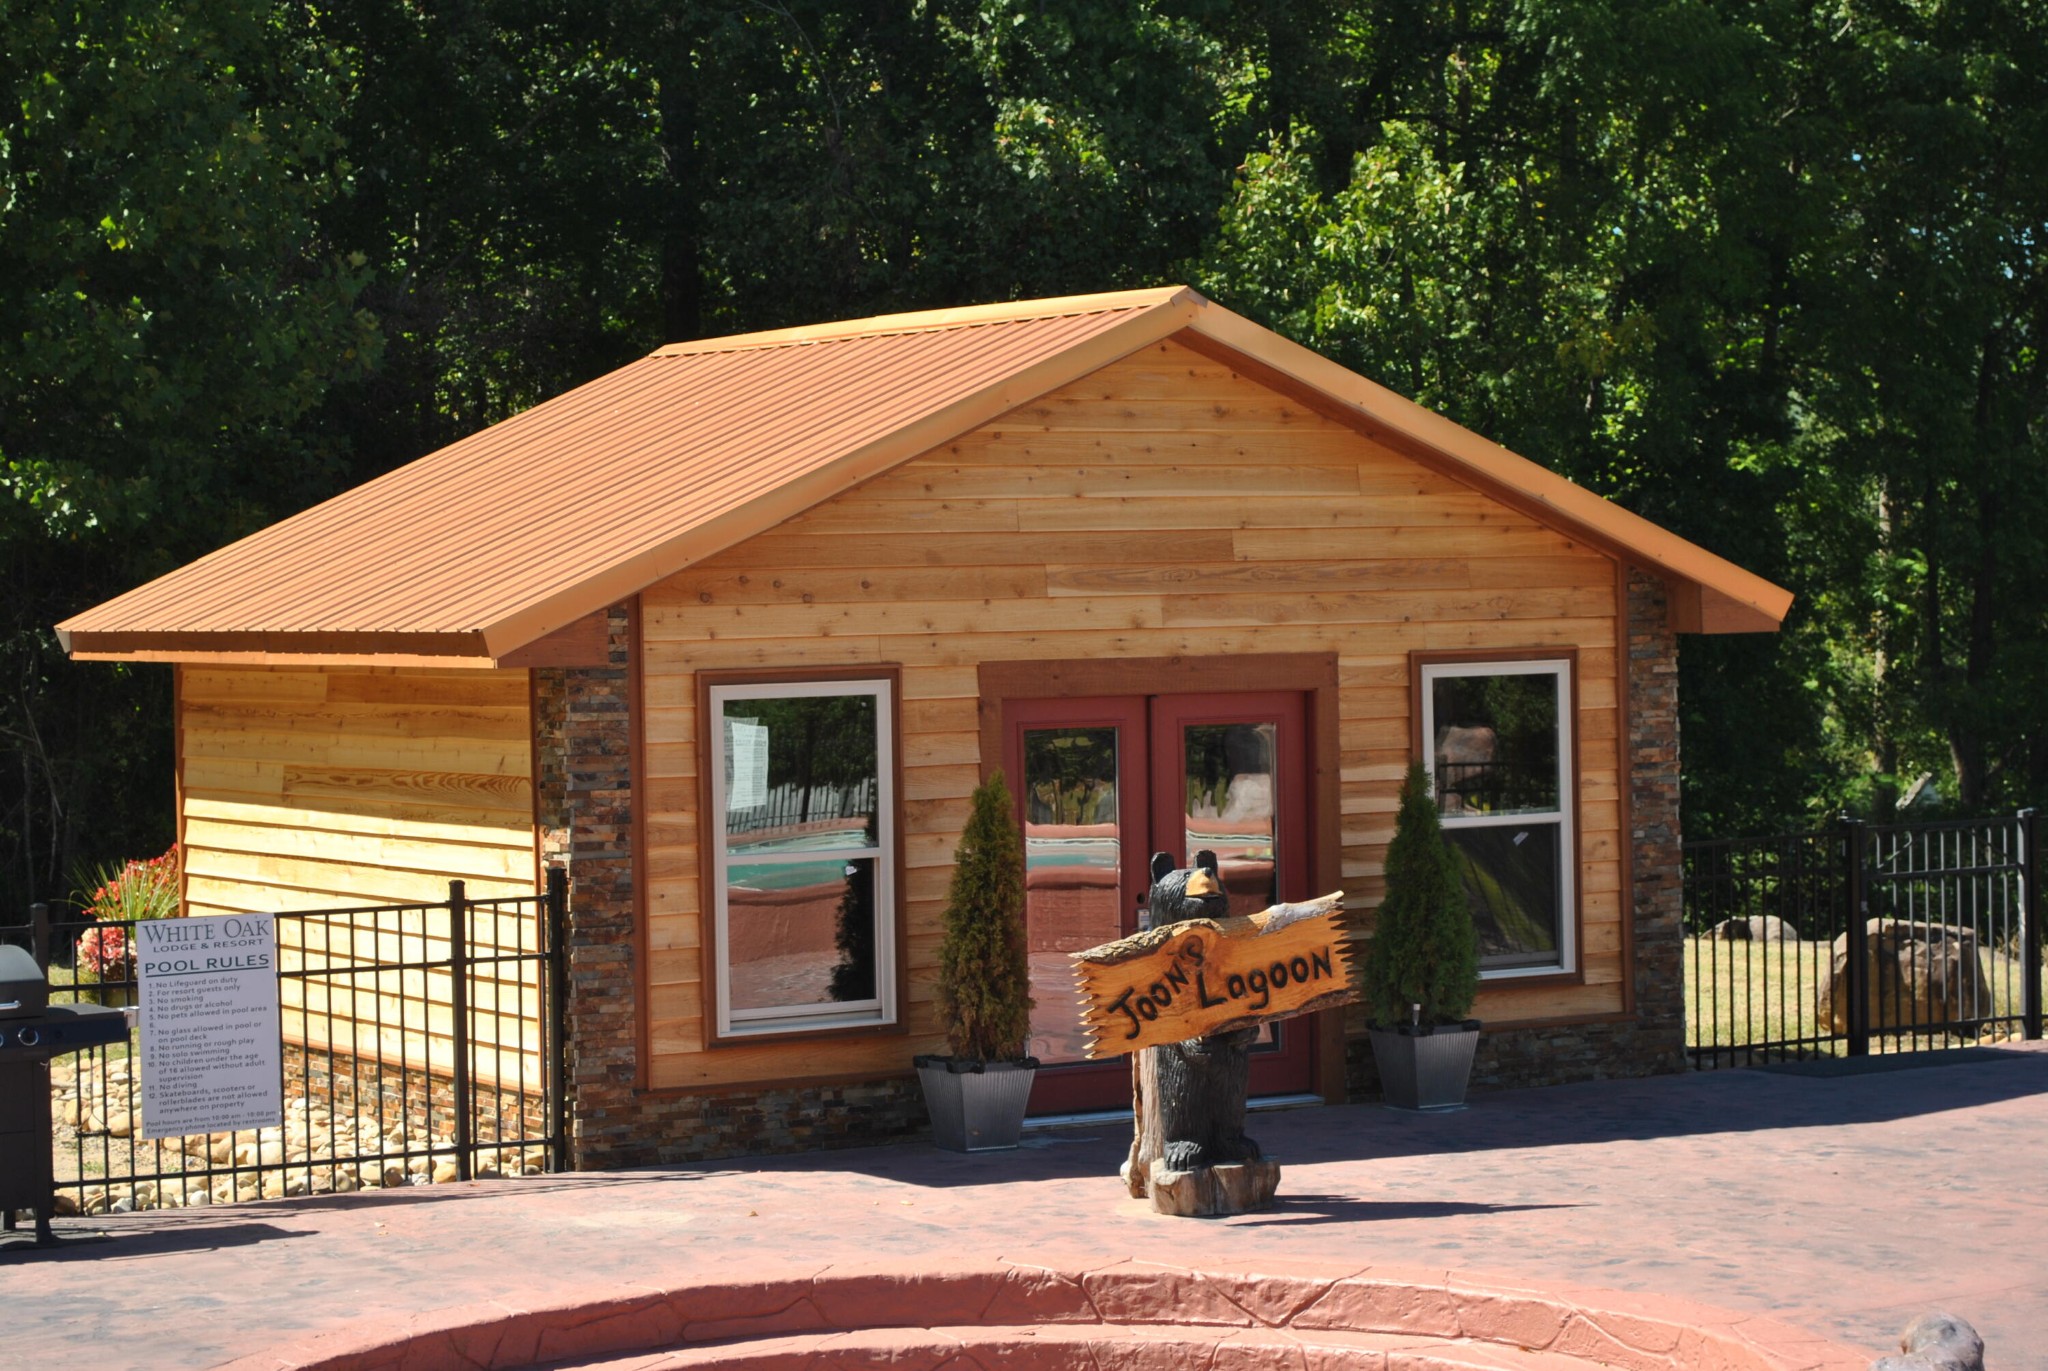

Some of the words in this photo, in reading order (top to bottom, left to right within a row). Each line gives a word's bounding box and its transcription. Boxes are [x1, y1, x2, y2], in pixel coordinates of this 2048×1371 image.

[153, 944, 197, 952] LODGE
[214, 939, 264, 948] RESORT
[145, 960, 199, 973] POOL
[207, 954, 269, 969] RULES
[169, 979, 206, 989] Lifeguard
[220, 977, 238, 985] duty
[197, 986, 222, 995] guests
[224, 984, 240, 992] only
[170, 995, 204, 1005] smoking
[170, 1004, 192, 1012] drugs
[190, 1009, 221, 1018] allowed
[231, 1007, 249, 1015] pool
[171, 1028, 191, 1036] glass
[193, 1024, 224, 1032] allowed
[235, 1021, 252, 1029] pool
[170, 1035, 187, 1043] pool
[172, 1041, 202, 1050] running
[214, 1038, 236, 1046] rough
[238, 1037, 255, 1045] play
[190, 1047, 230, 1056] swimming
[172, 1058, 204, 1066] children
[206, 1055, 228, 1063] under
[180, 1064, 211, 1073] allowed
[213, 1062, 243, 1070] without
[159, 1073, 203, 1084] supervision
[173, 1082, 198, 1090] diving
[159, 1096, 205, 1106] rollerblades
[237, 1090, 268, 1099] allowed
[160, 1088, 210, 1098] Skateboards,
[160, 1105, 197, 1114] anywhere
[212, 1101, 245, 1110] property
[147, 1126, 183, 1135] Emergency
[185, 1124, 205, 1133] phone
[242, 1117, 275, 1125] restrooms
